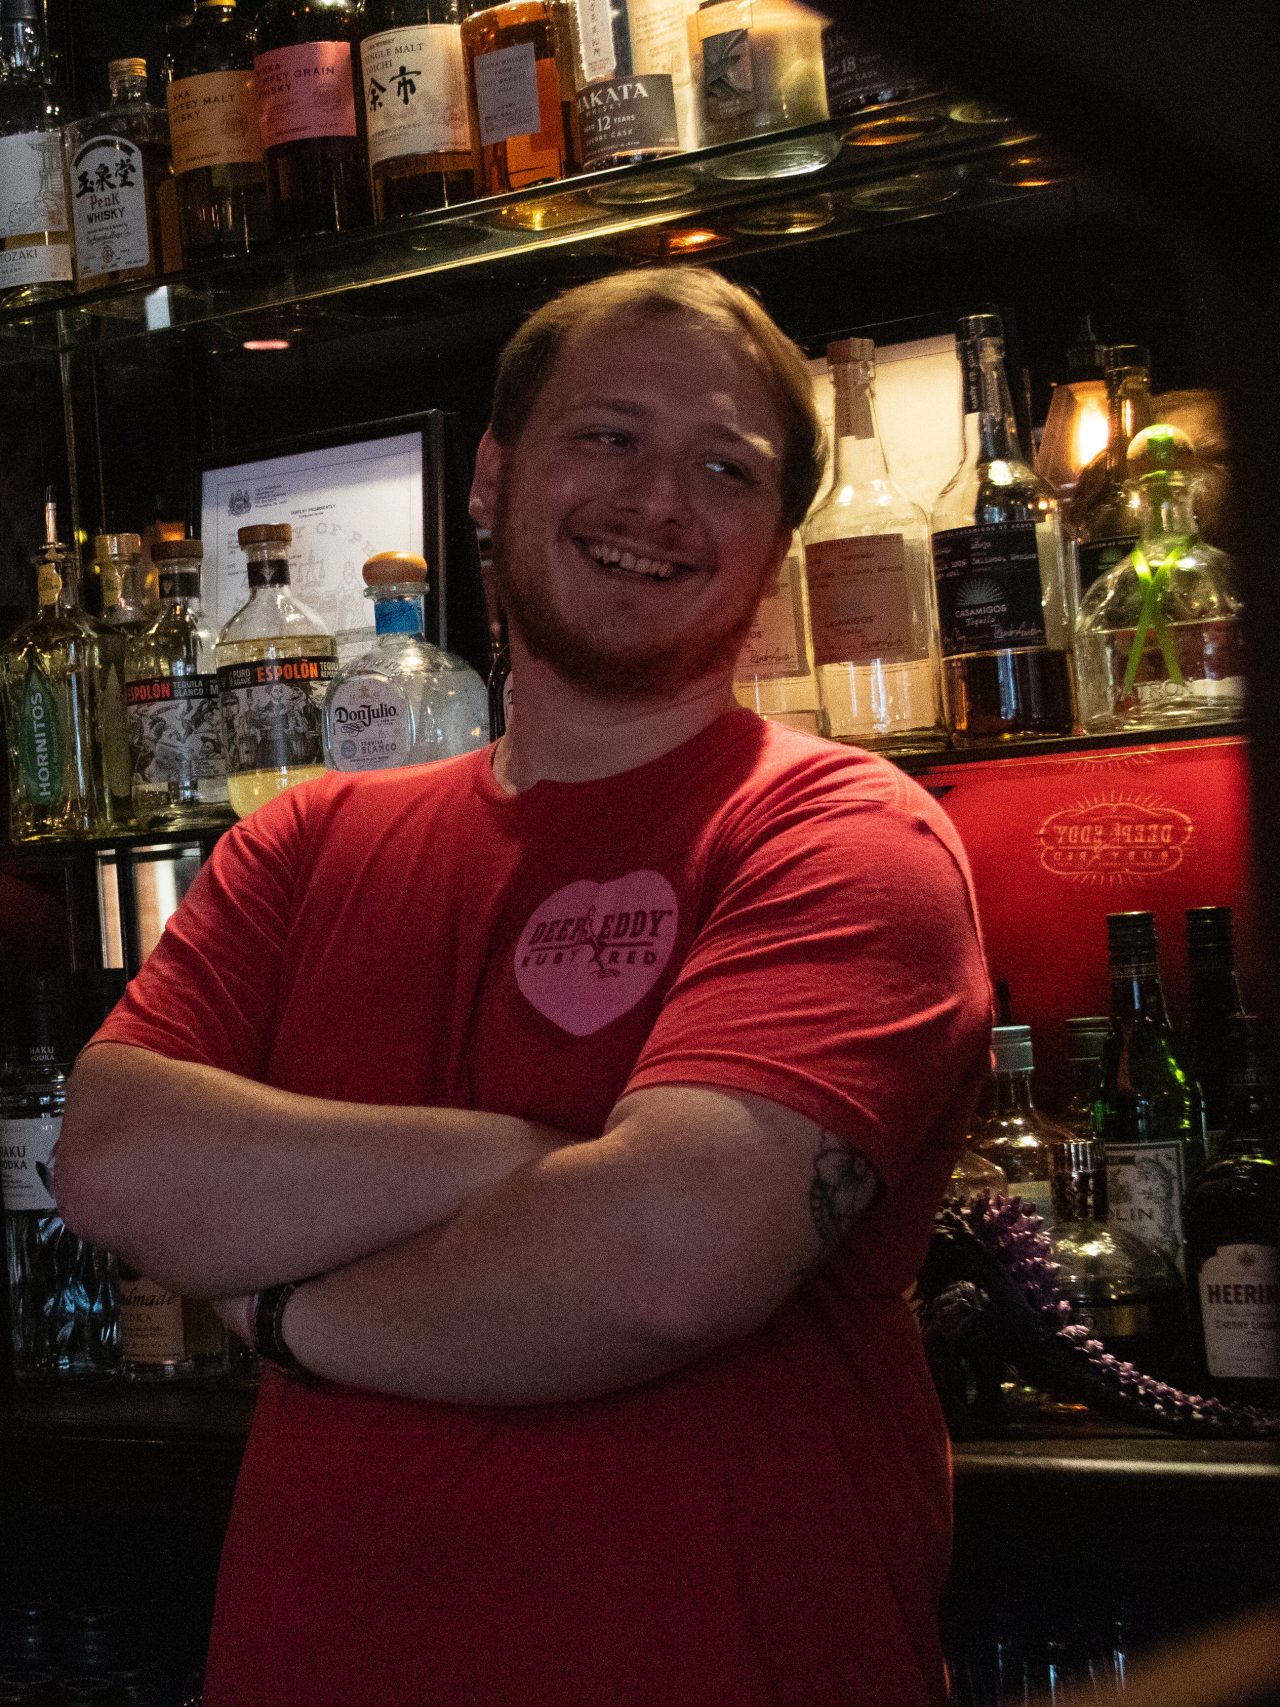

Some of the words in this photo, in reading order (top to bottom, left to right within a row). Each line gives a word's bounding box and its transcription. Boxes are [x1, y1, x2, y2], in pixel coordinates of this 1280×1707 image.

[394, 43, 425, 54] MALT
[841, 55, 857, 74] 18
[293, 66, 335, 78] GRAIN
[367, 65, 422, 112] 余市
[202, 94, 235, 106] MALT
[597, 116, 611, 132] 12
[613, 114, 635, 124] YEARS
[610, 128, 634, 138] CASK
[76, 158, 136, 198] 玉泉堂
[87, 207, 126, 224] WHISKY
[955, 604, 1008, 618] CASAMIGOS
[232, 667, 252, 679] PURO
[173, 680, 203, 689] TEQUILA
[173, 687, 204, 697] BLANCO
[30, 692, 52, 797] HORNITOS
[361, 743, 397, 755] BLANCO
[528, 916, 589, 945] DEEP
[598, 909, 674, 939] EDDY
[608, 951, 658, 966] RED
[2, 1159, 28, 1170] ODKA
